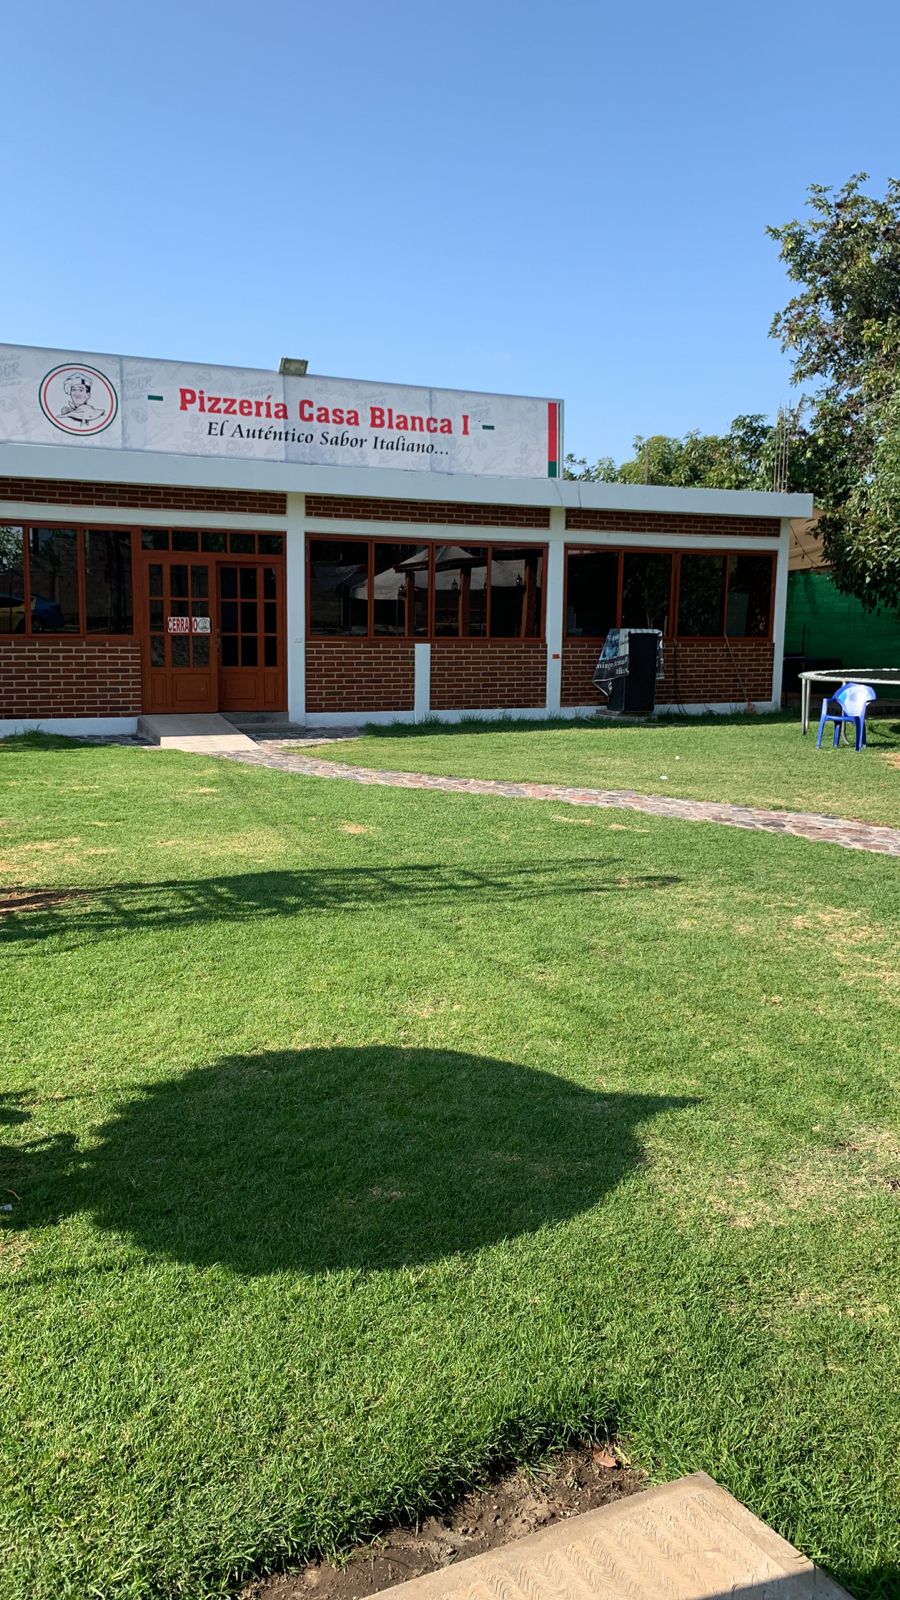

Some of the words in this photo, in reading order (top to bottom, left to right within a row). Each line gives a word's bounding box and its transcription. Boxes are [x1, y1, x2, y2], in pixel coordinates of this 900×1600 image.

[179, 388, 288, 420] Pizzería
[299, 399, 360, 427] Casa
[369, 406, 453, 434] Blanca
[462, 415, 469, 435] I
[207, 420, 229, 437] El
[230, 423, 314, 444] Auténtico
[320, 430, 368, 449] Sabor
[371, 435, 449, 455] Italiano...
[168, 618, 197, 632] CERRAO
